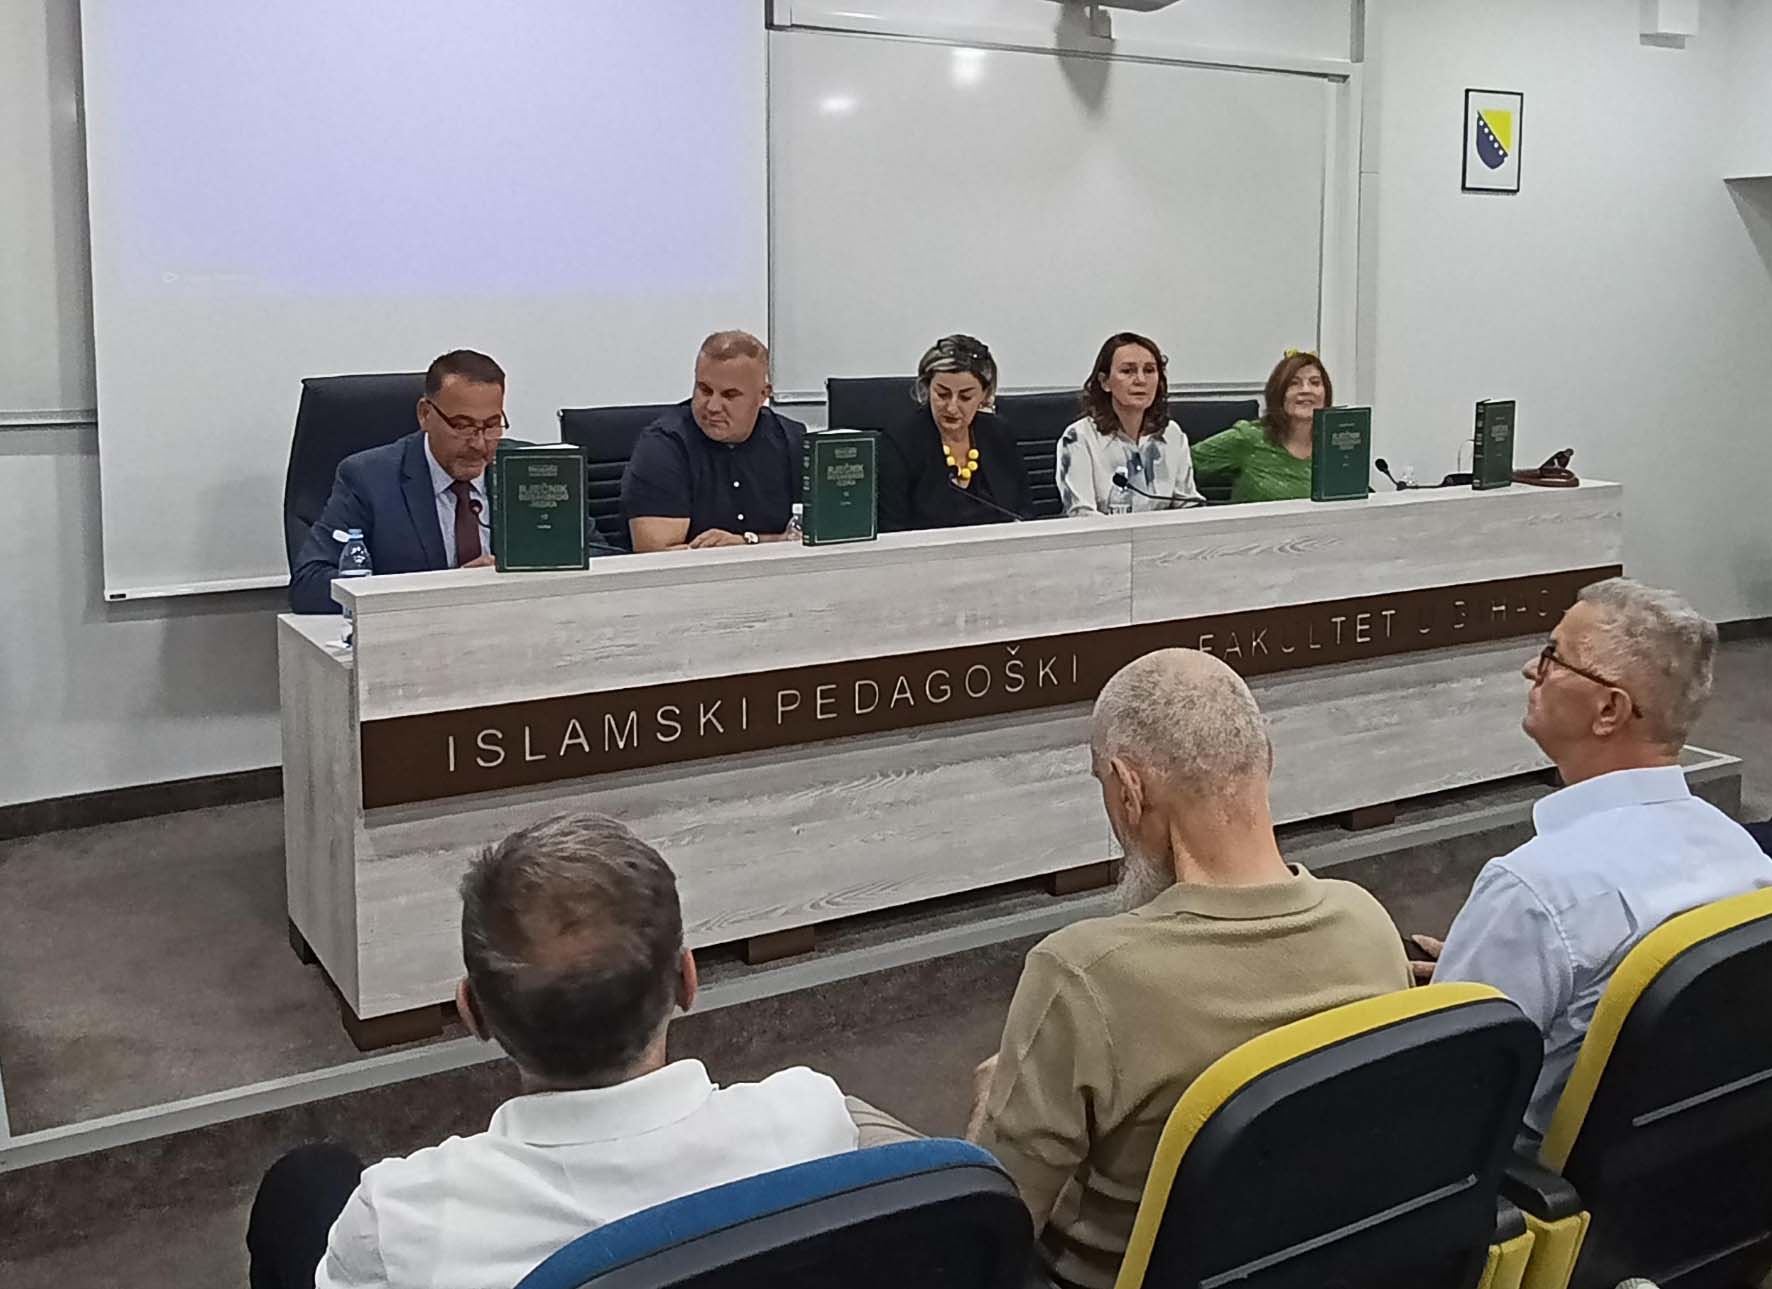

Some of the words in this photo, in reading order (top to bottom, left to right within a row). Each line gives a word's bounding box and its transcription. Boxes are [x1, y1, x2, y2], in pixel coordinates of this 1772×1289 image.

[449, 697, 747, 772] ISLAMSKI
[777, 645, 1077, 725] PEDAGOŠKI
[1199, 610, 1396, 660] FAKLTET
